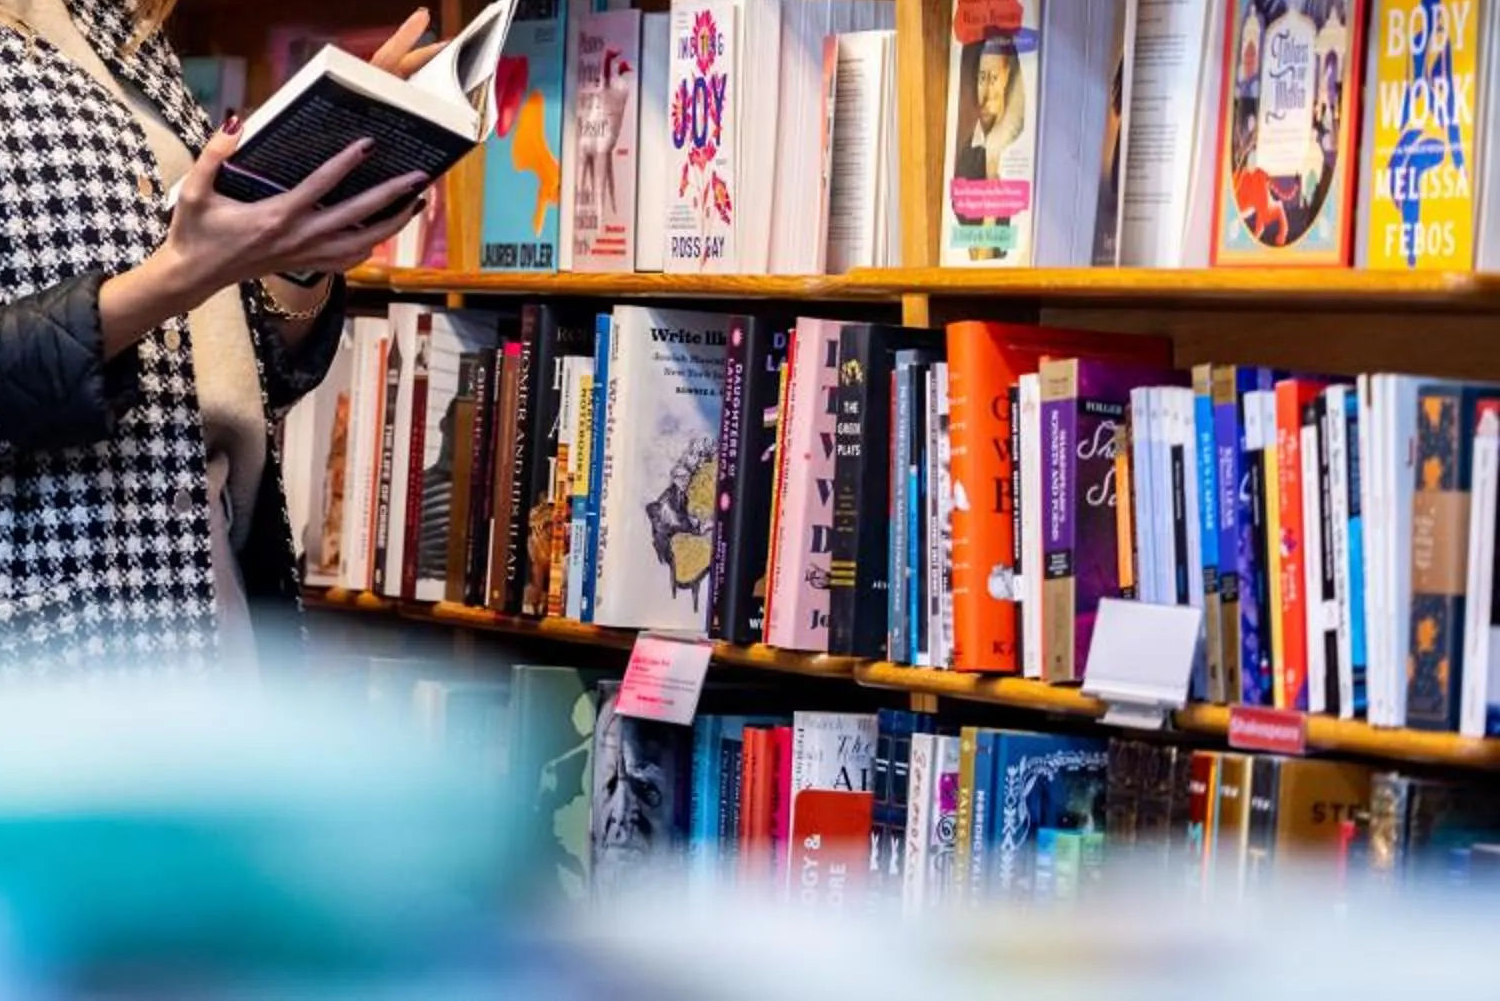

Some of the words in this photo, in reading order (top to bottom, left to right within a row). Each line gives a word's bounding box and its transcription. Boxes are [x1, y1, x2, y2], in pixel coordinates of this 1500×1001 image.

[1387, 0, 1472, 57] BODY
[672, 73, 727, 150] JOY
[1380, 72, 1473, 130] WORK
[1375, 165, 1471, 201] MELISSA
[481, 242, 517, 269] LAUREN
[518, 243, 553, 269] OYLER
[671, 236, 701, 258] ROSS
[703, 236, 725, 258] GAY
[1384, 221, 1456, 259] FEBOS
[650, 328, 702, 345] Write
[516, 341, 532, 421] HOMER
[725, 358, 735, 401] LATIN
[729, 364, 743, 458] DAUGHTERS
[843, 400, 859, 415] THE
[1086, 402, 1122, 415] FOLGER
[385, 424, 394, 449] THE
[576, 388, 588, 483] NOTEBOOKS
[719, 408, 731, 481] AMERICA
[837, 422, 861, 435] GREEK
[1050, 410, 1061, 465] SONNETS
[382, 452, 392, 480] LIFE
[512, 427, 525, 474] AND
[837, 445, 861, 457] PLAYS
[381, 484, 390, 502] OF
[510, 480, 521, 518] HIS
[1050, 468, 1060, 496] AND
[378, 505, 389, 549] CRIME
[506, 523, 519, 583] ILIAD
[973, 790, 985, 852] NORDIC
[804, 834, 821, 849] &
